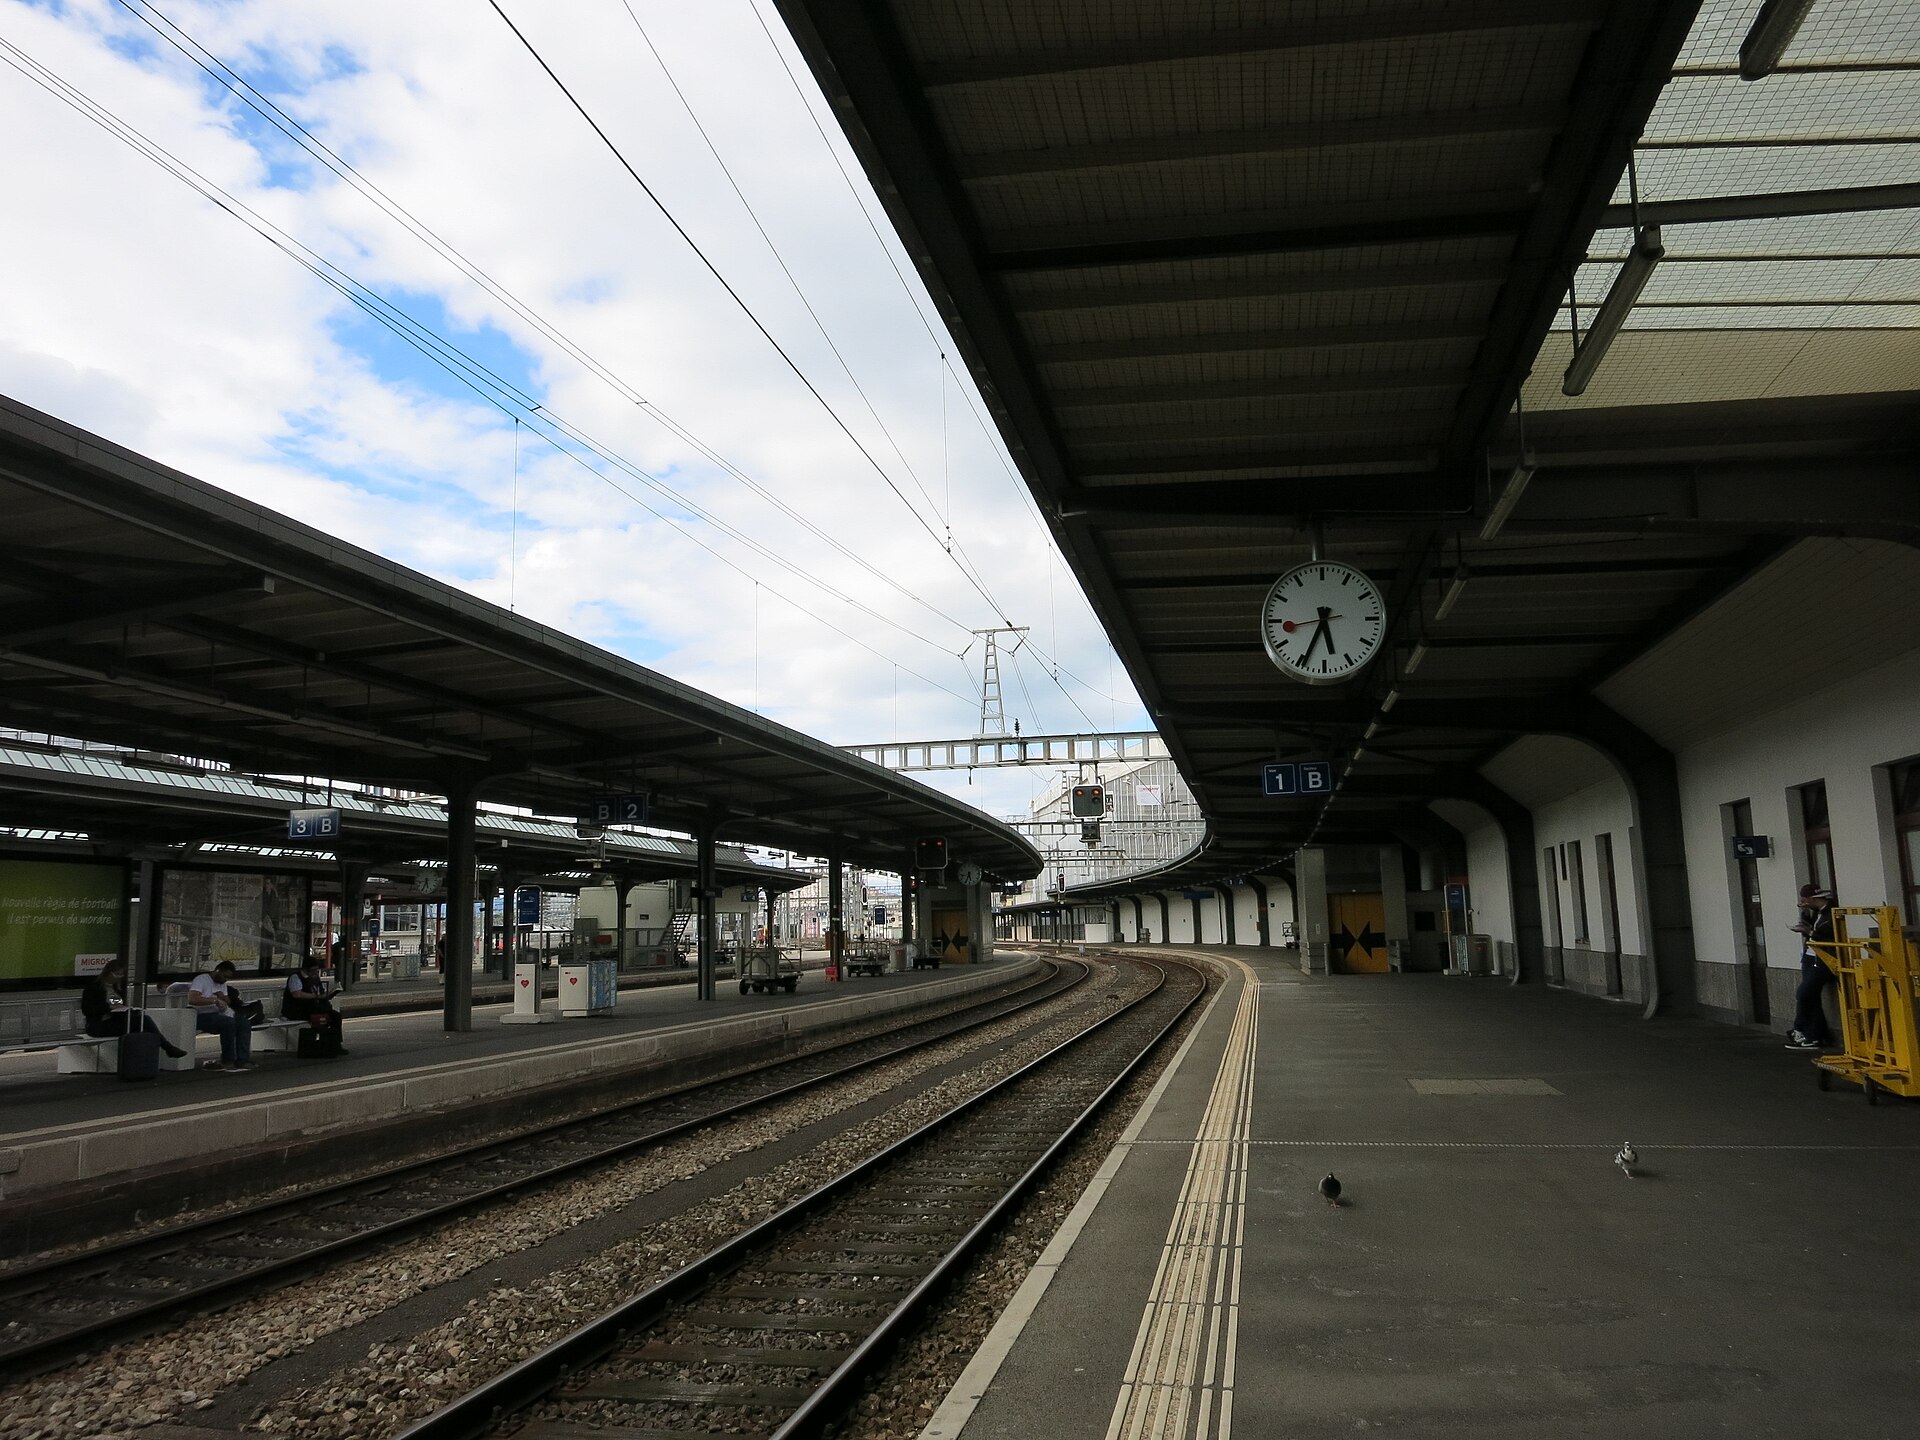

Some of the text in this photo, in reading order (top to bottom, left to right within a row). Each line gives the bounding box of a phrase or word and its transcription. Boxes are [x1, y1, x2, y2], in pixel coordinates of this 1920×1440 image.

[1275, 771, 1323, 790] 1 B
[598, 803, 638, 820] B 2
[296, 818, 332, 834] 3 B
[1, 896, 40, 908] Nouvelle
[68, 897, 80, 908] de
[15, 915, 31, 925] est
[31, 915, 64, 927] permis
[66, 913, 78, 925] de
[81, 957, 111, 966] MIGROS
